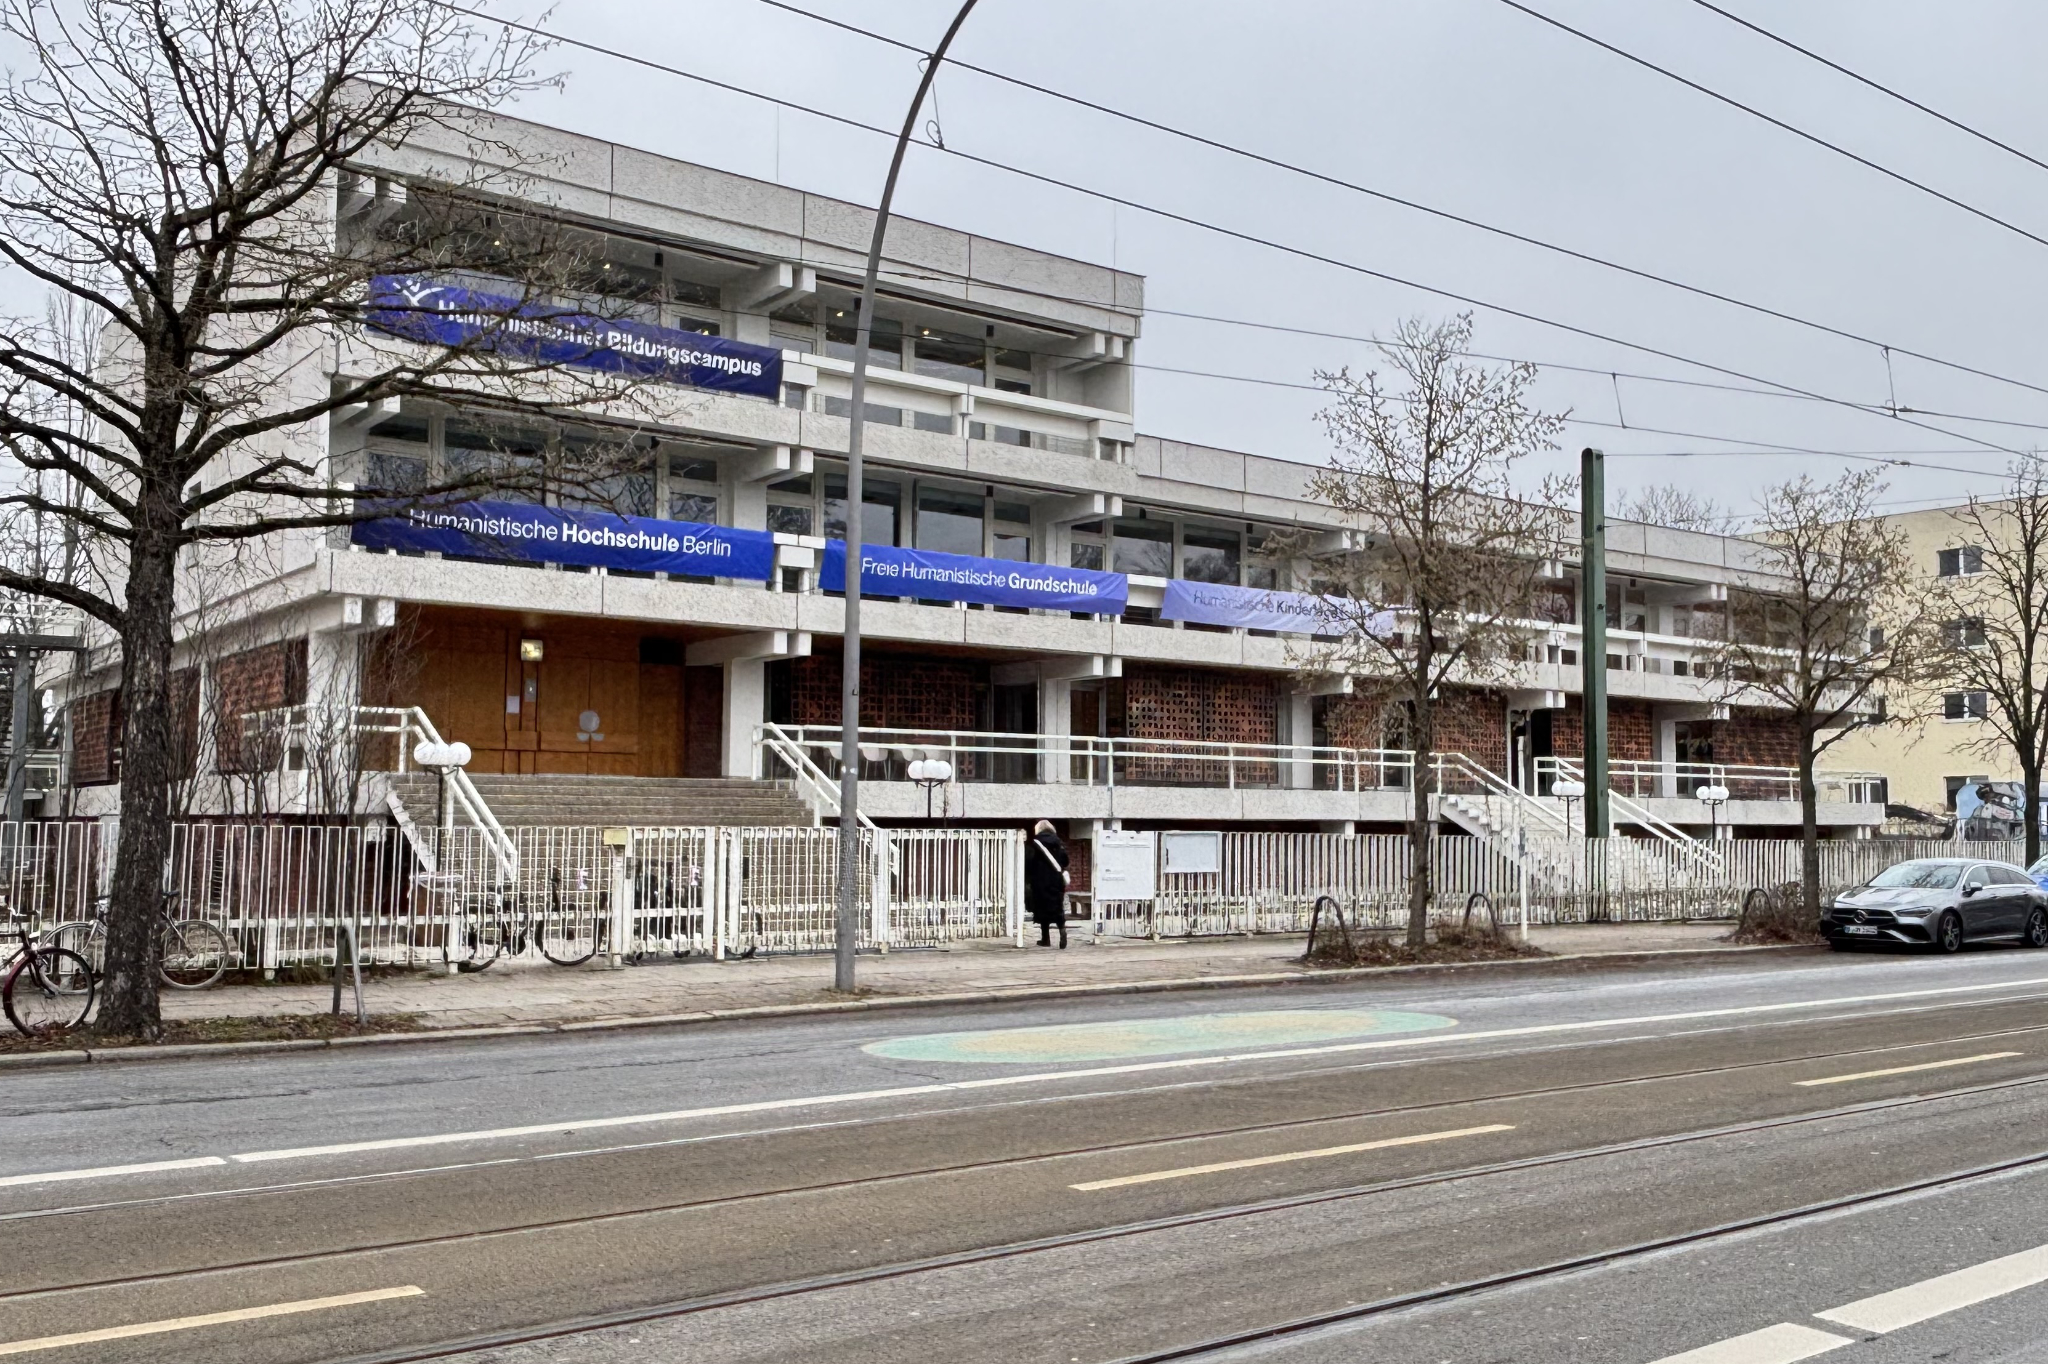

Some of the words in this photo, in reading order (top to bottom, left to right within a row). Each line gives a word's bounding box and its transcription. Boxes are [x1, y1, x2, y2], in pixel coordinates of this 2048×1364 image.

[438, 300, 604, 347] Humnistischer
[608, 331, 762, 377] Bildungscampus
[409, 508, 558, 541] Humanistische
[562, 523, 679, 553] Hochschule
[683, 535, 731, 557] Berlin
[862, 557, 899, 577] Freie
[902, 561, 1006, 587] Humanistische
[1008, 572, 1097, 596] Grundschule
